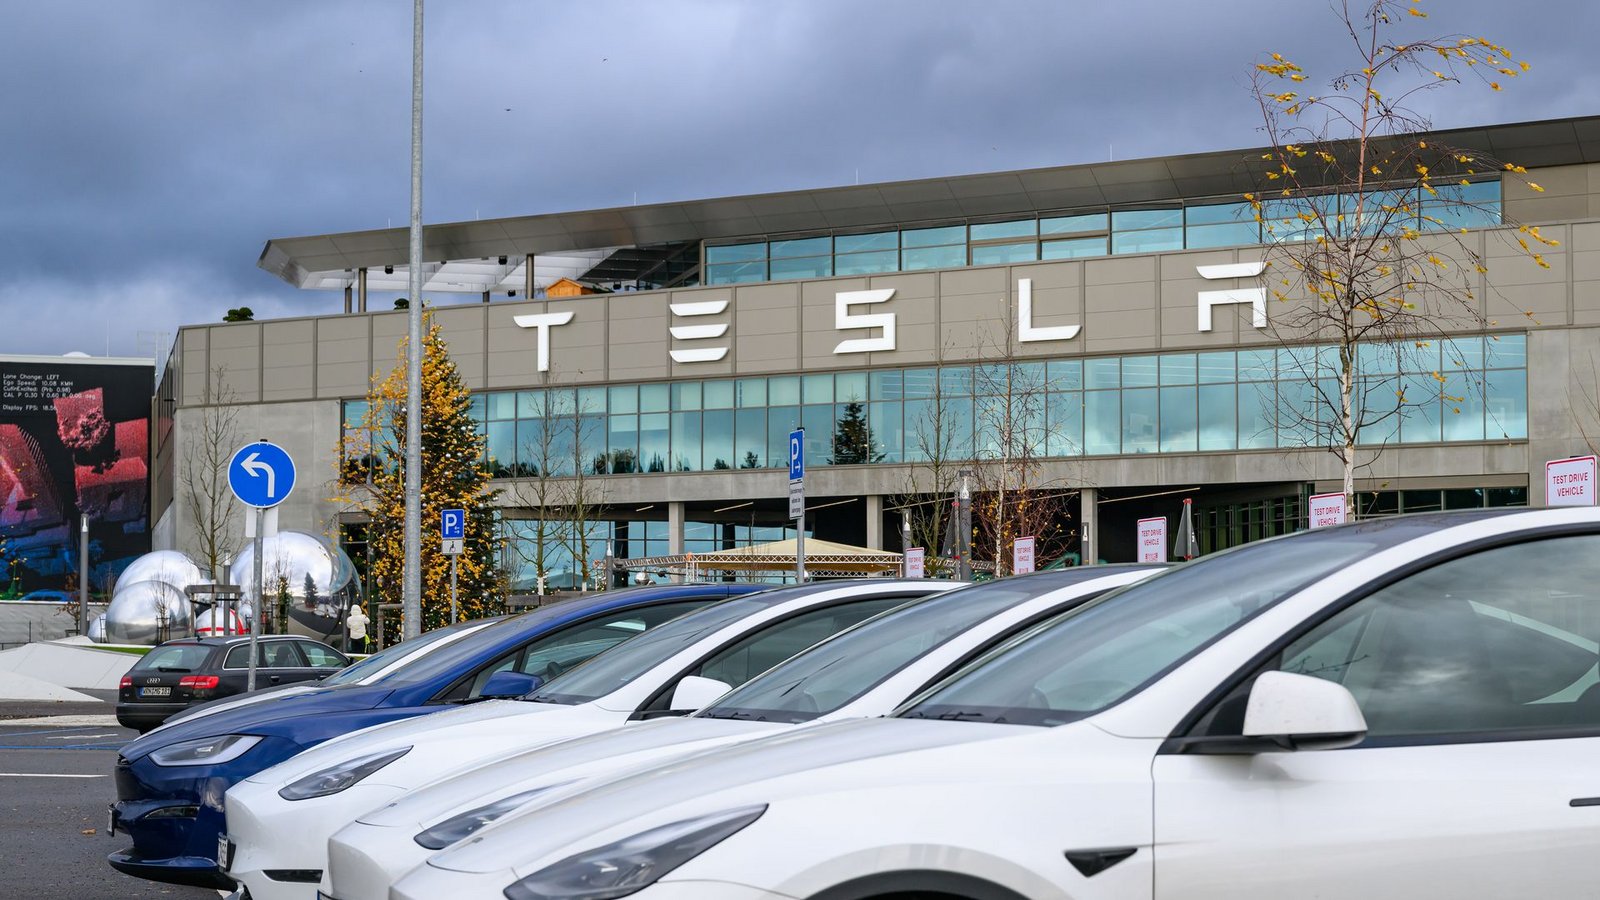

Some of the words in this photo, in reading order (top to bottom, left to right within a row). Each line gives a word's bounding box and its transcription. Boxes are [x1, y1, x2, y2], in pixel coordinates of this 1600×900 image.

[513, 261, 1267, 371] TESLA
[20, 373, 42, 381] Change:
[791, 438, 799, 474] P
[1552, 475, 1567, 485] TEST
[1568, 472, 1588, 483] DRIVE
[1557, 486, 1584, 497] VEHICLE
[1314, 507, 1325, 515] TEST
[1326, 506, 1340, 515] DRIVE
[445, 513, 457, 534] P
[1317, 518, 1337, 526] VEHICLE
